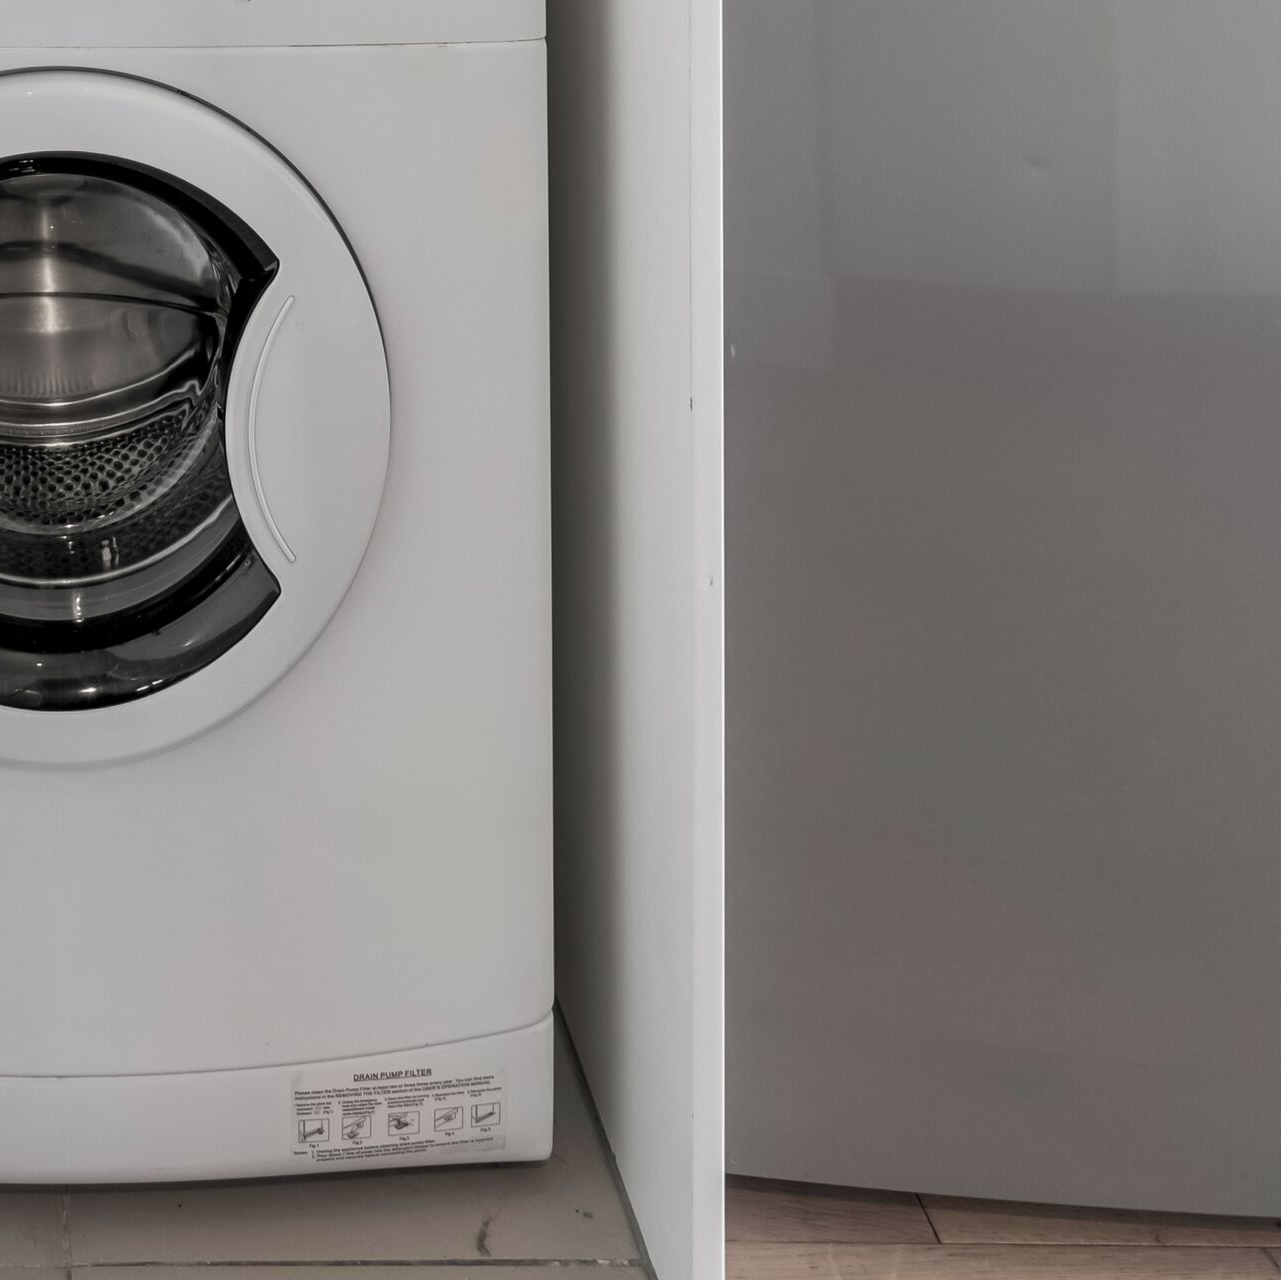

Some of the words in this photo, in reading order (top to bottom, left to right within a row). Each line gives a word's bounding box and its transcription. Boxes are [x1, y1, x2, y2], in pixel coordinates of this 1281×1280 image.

[353, 1073, 378, 1082] DRAIN
[380, 1071, 403, 1079] PUMP
[405, 1068, 432, 1077] FILTER
